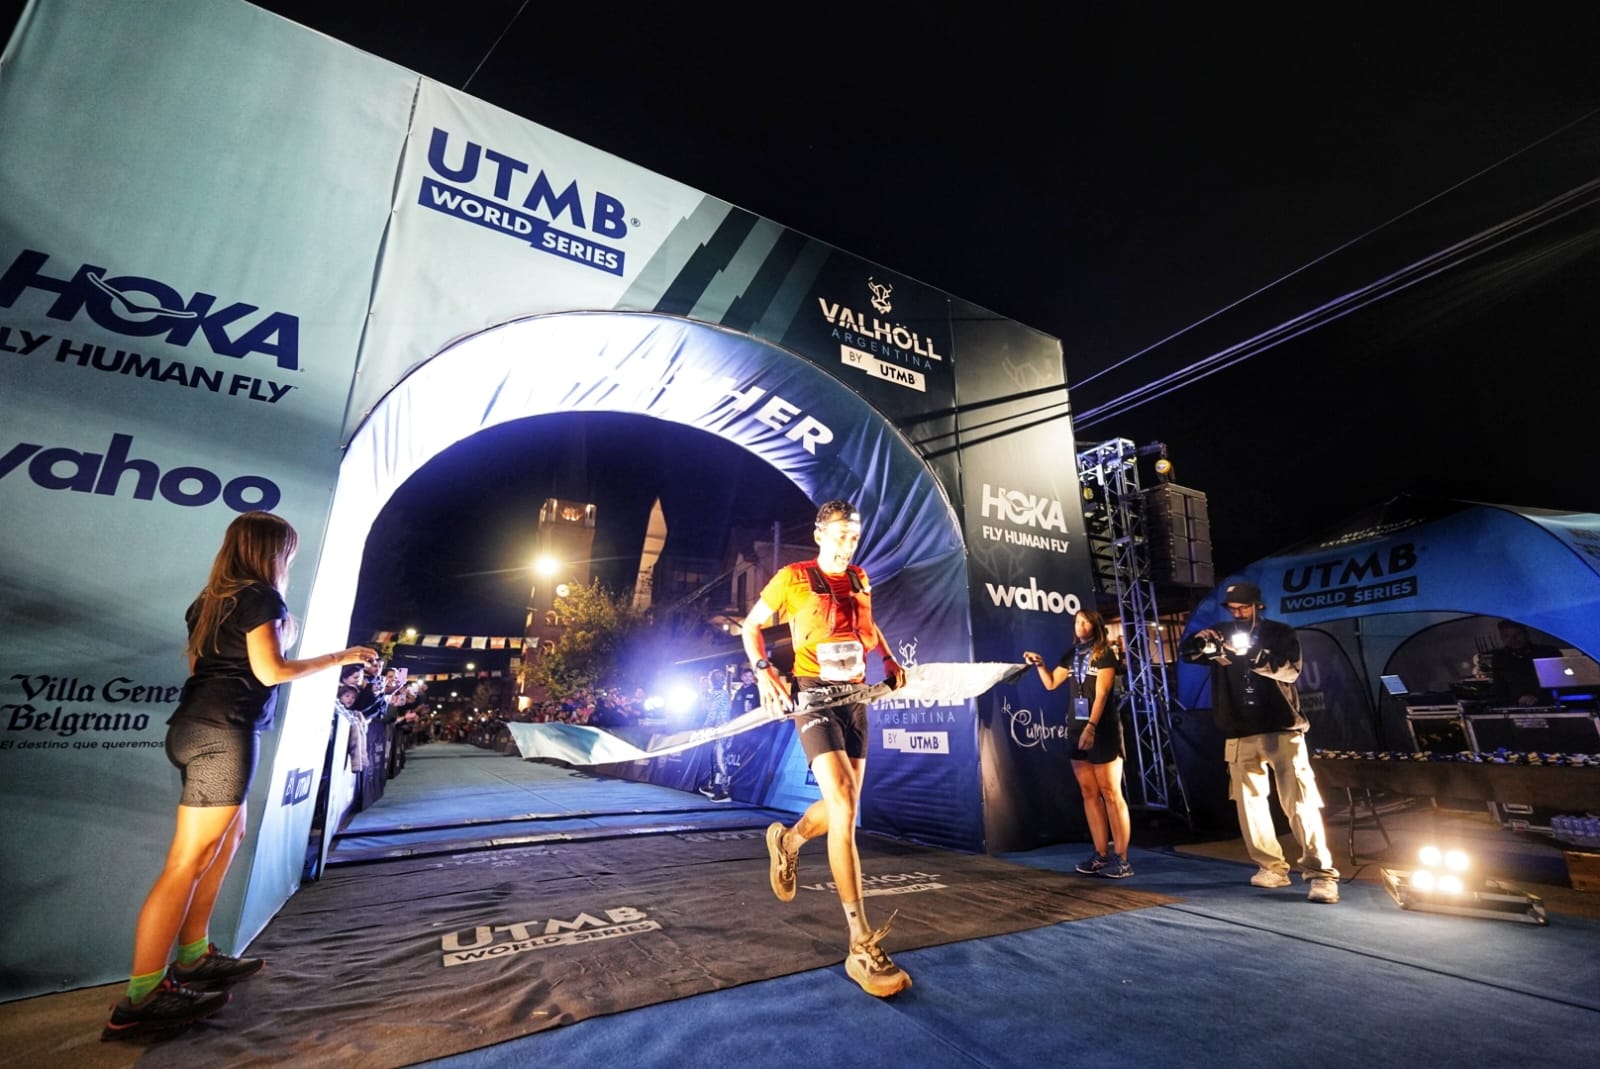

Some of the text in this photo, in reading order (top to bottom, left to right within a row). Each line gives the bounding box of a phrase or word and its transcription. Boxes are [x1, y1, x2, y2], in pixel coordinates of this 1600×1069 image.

[431, 185, 618, 270] WORLD SERIES
[0, 249, 300, 371] HOKA
[818, 297, 943, 361] VALHÖLL
[831, 328, 932, 371] ARGENTINA
[849, 351, 915, 385] BY UTMB
[55, 338, 225, 393] HUMAN
[228, 373, 294, 404] FLY
[0, 432, 282, 513] ahoo
[981, 483, 1069, 534] HOKA
[982, 525, 1070, 554] FLY HUMAN FLY
[985, 576, 1081, 616] wahoo
[1285, 580, 1412, 610] WORLD SERIES
[9, 673, 96, 702] Villa
[1, 703, 150, 737] Belgrano
[17, 740, 69, 749] destino
[72, 741, 98, 750] que
[887, 733, 939, 750] BY UTMB
[442, 906, 648, 951] UTMB
[455, 922, 652, 961] WORLD SERIES
